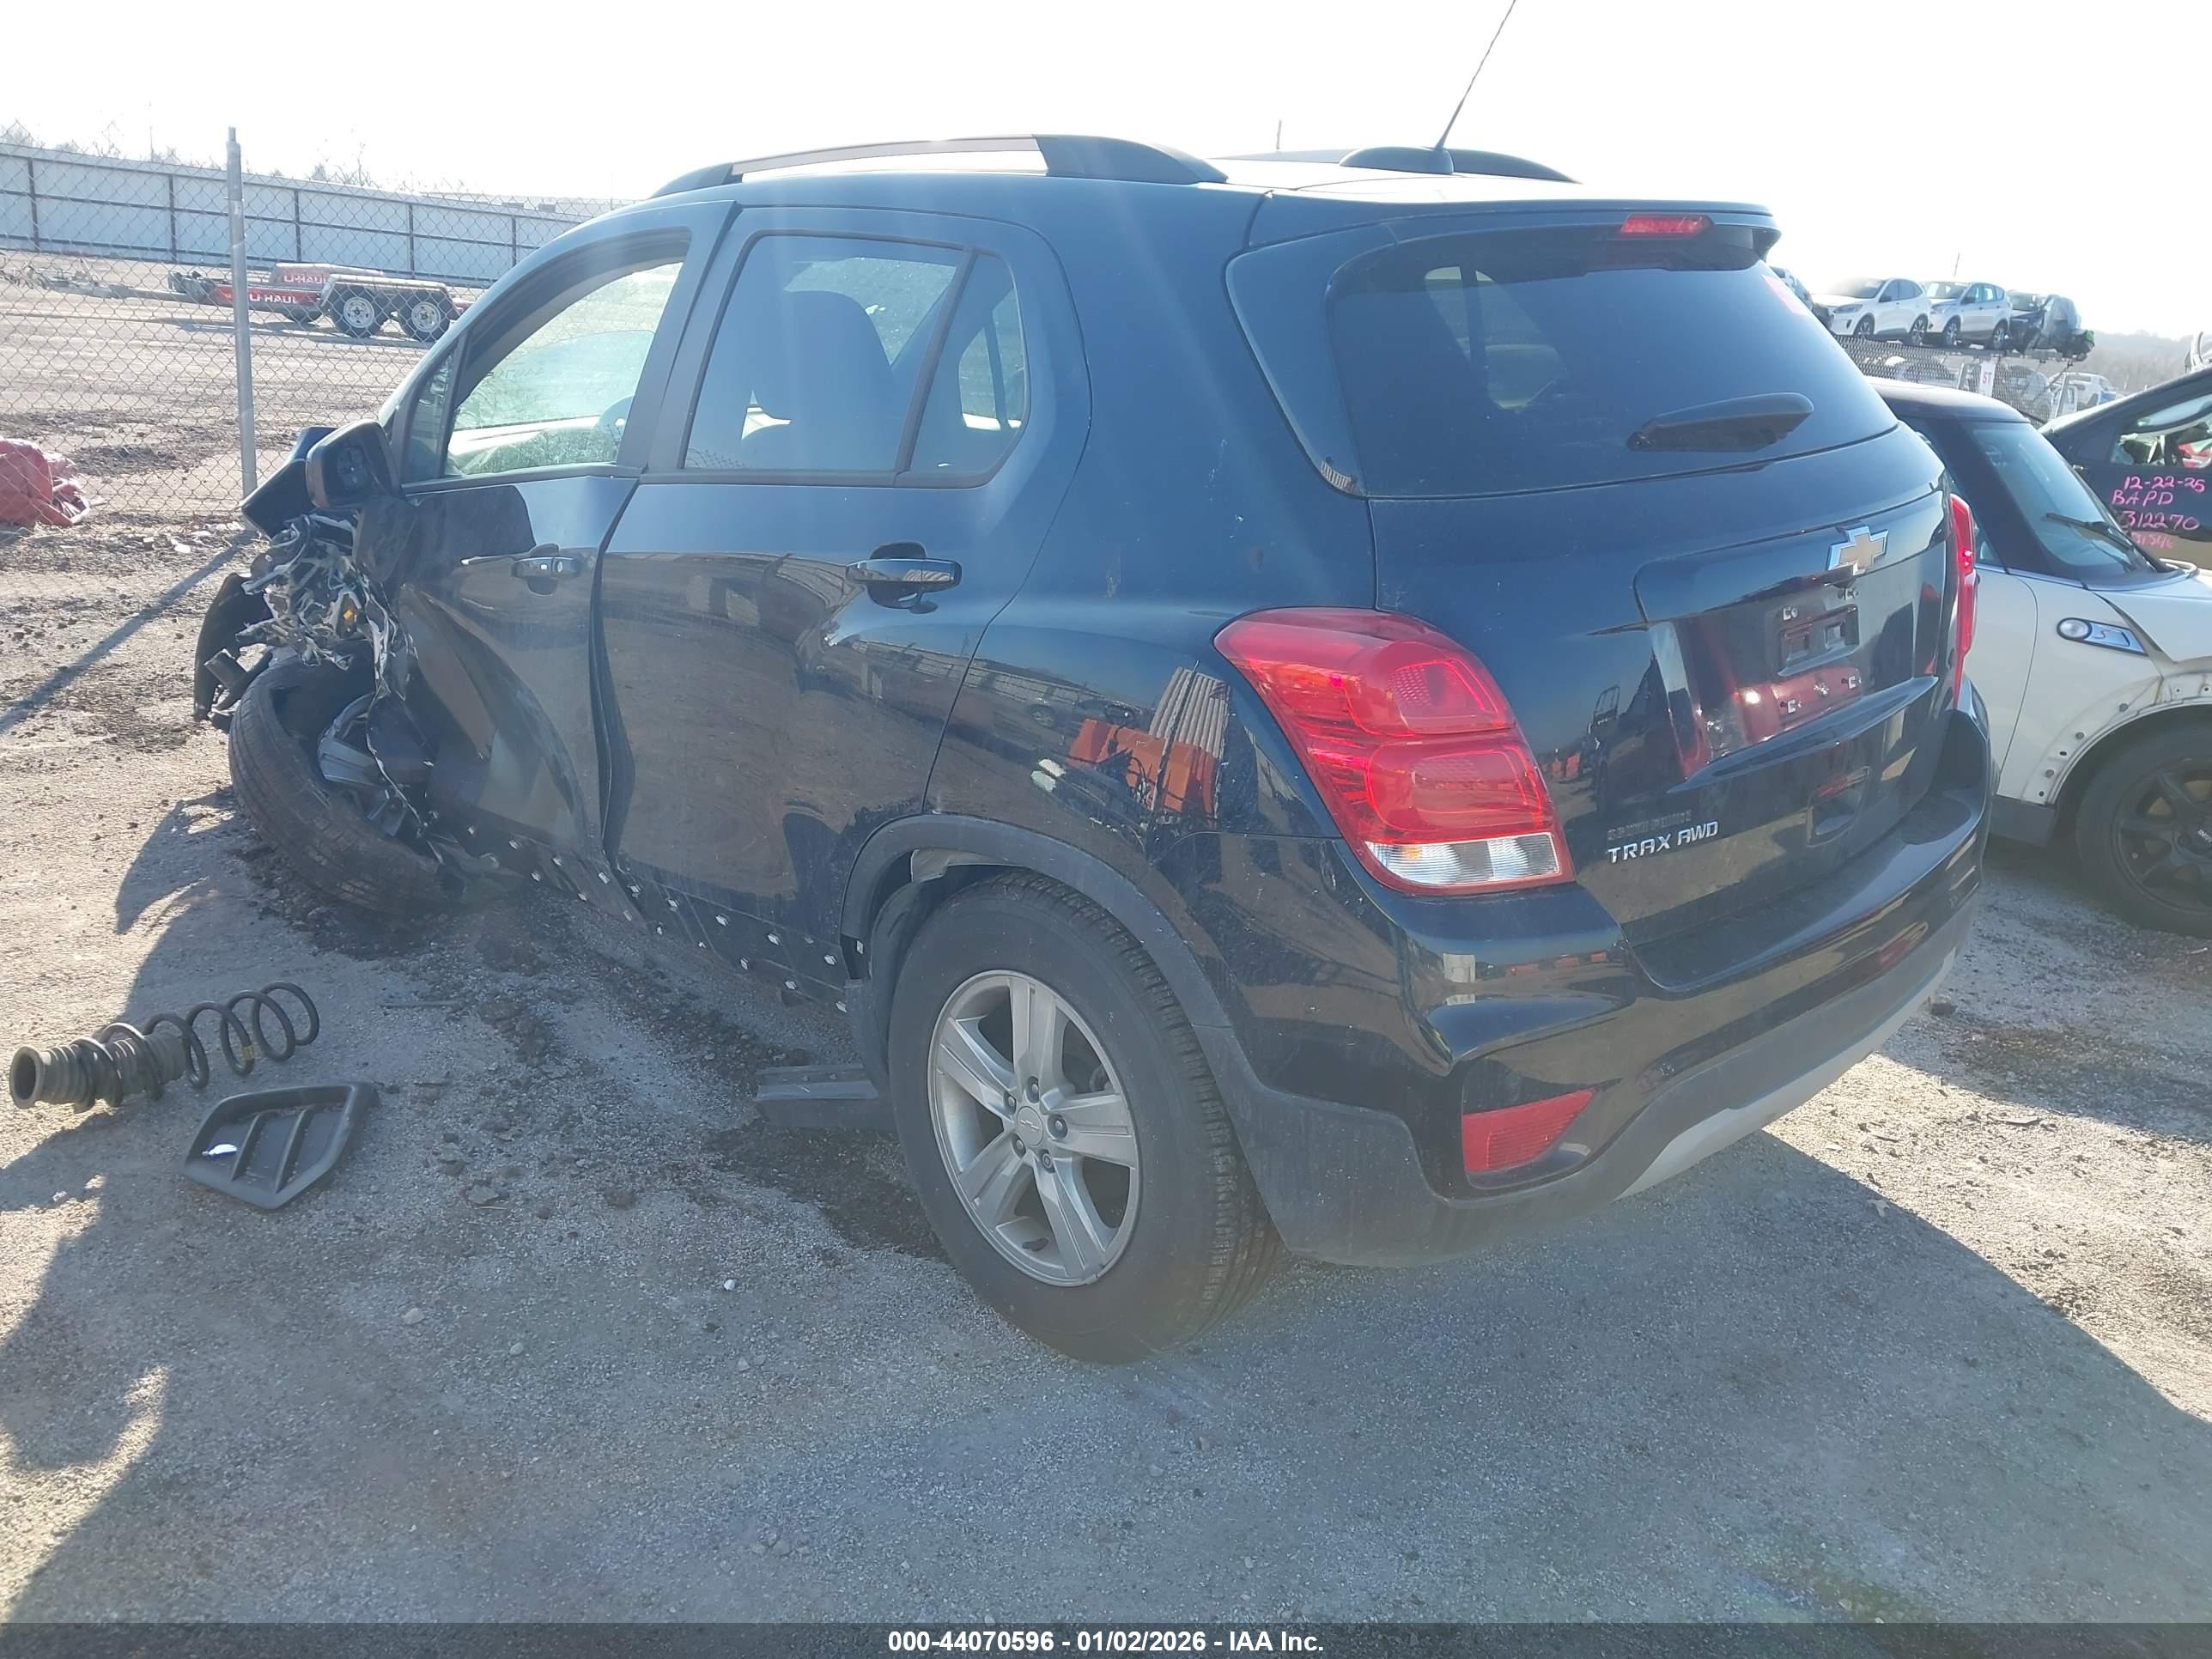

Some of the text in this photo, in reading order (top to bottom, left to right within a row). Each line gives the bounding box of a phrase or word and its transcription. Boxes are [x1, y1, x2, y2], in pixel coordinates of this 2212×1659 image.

[249, 293, 297, 303] UHAUL
[2124, 475, 2206, 493] 12-22-25
[2121, 510, 2200, 530] 312270
[1607, 833, 1671, 864] TRAX
[1677, 821, 1718, 846] AWD
